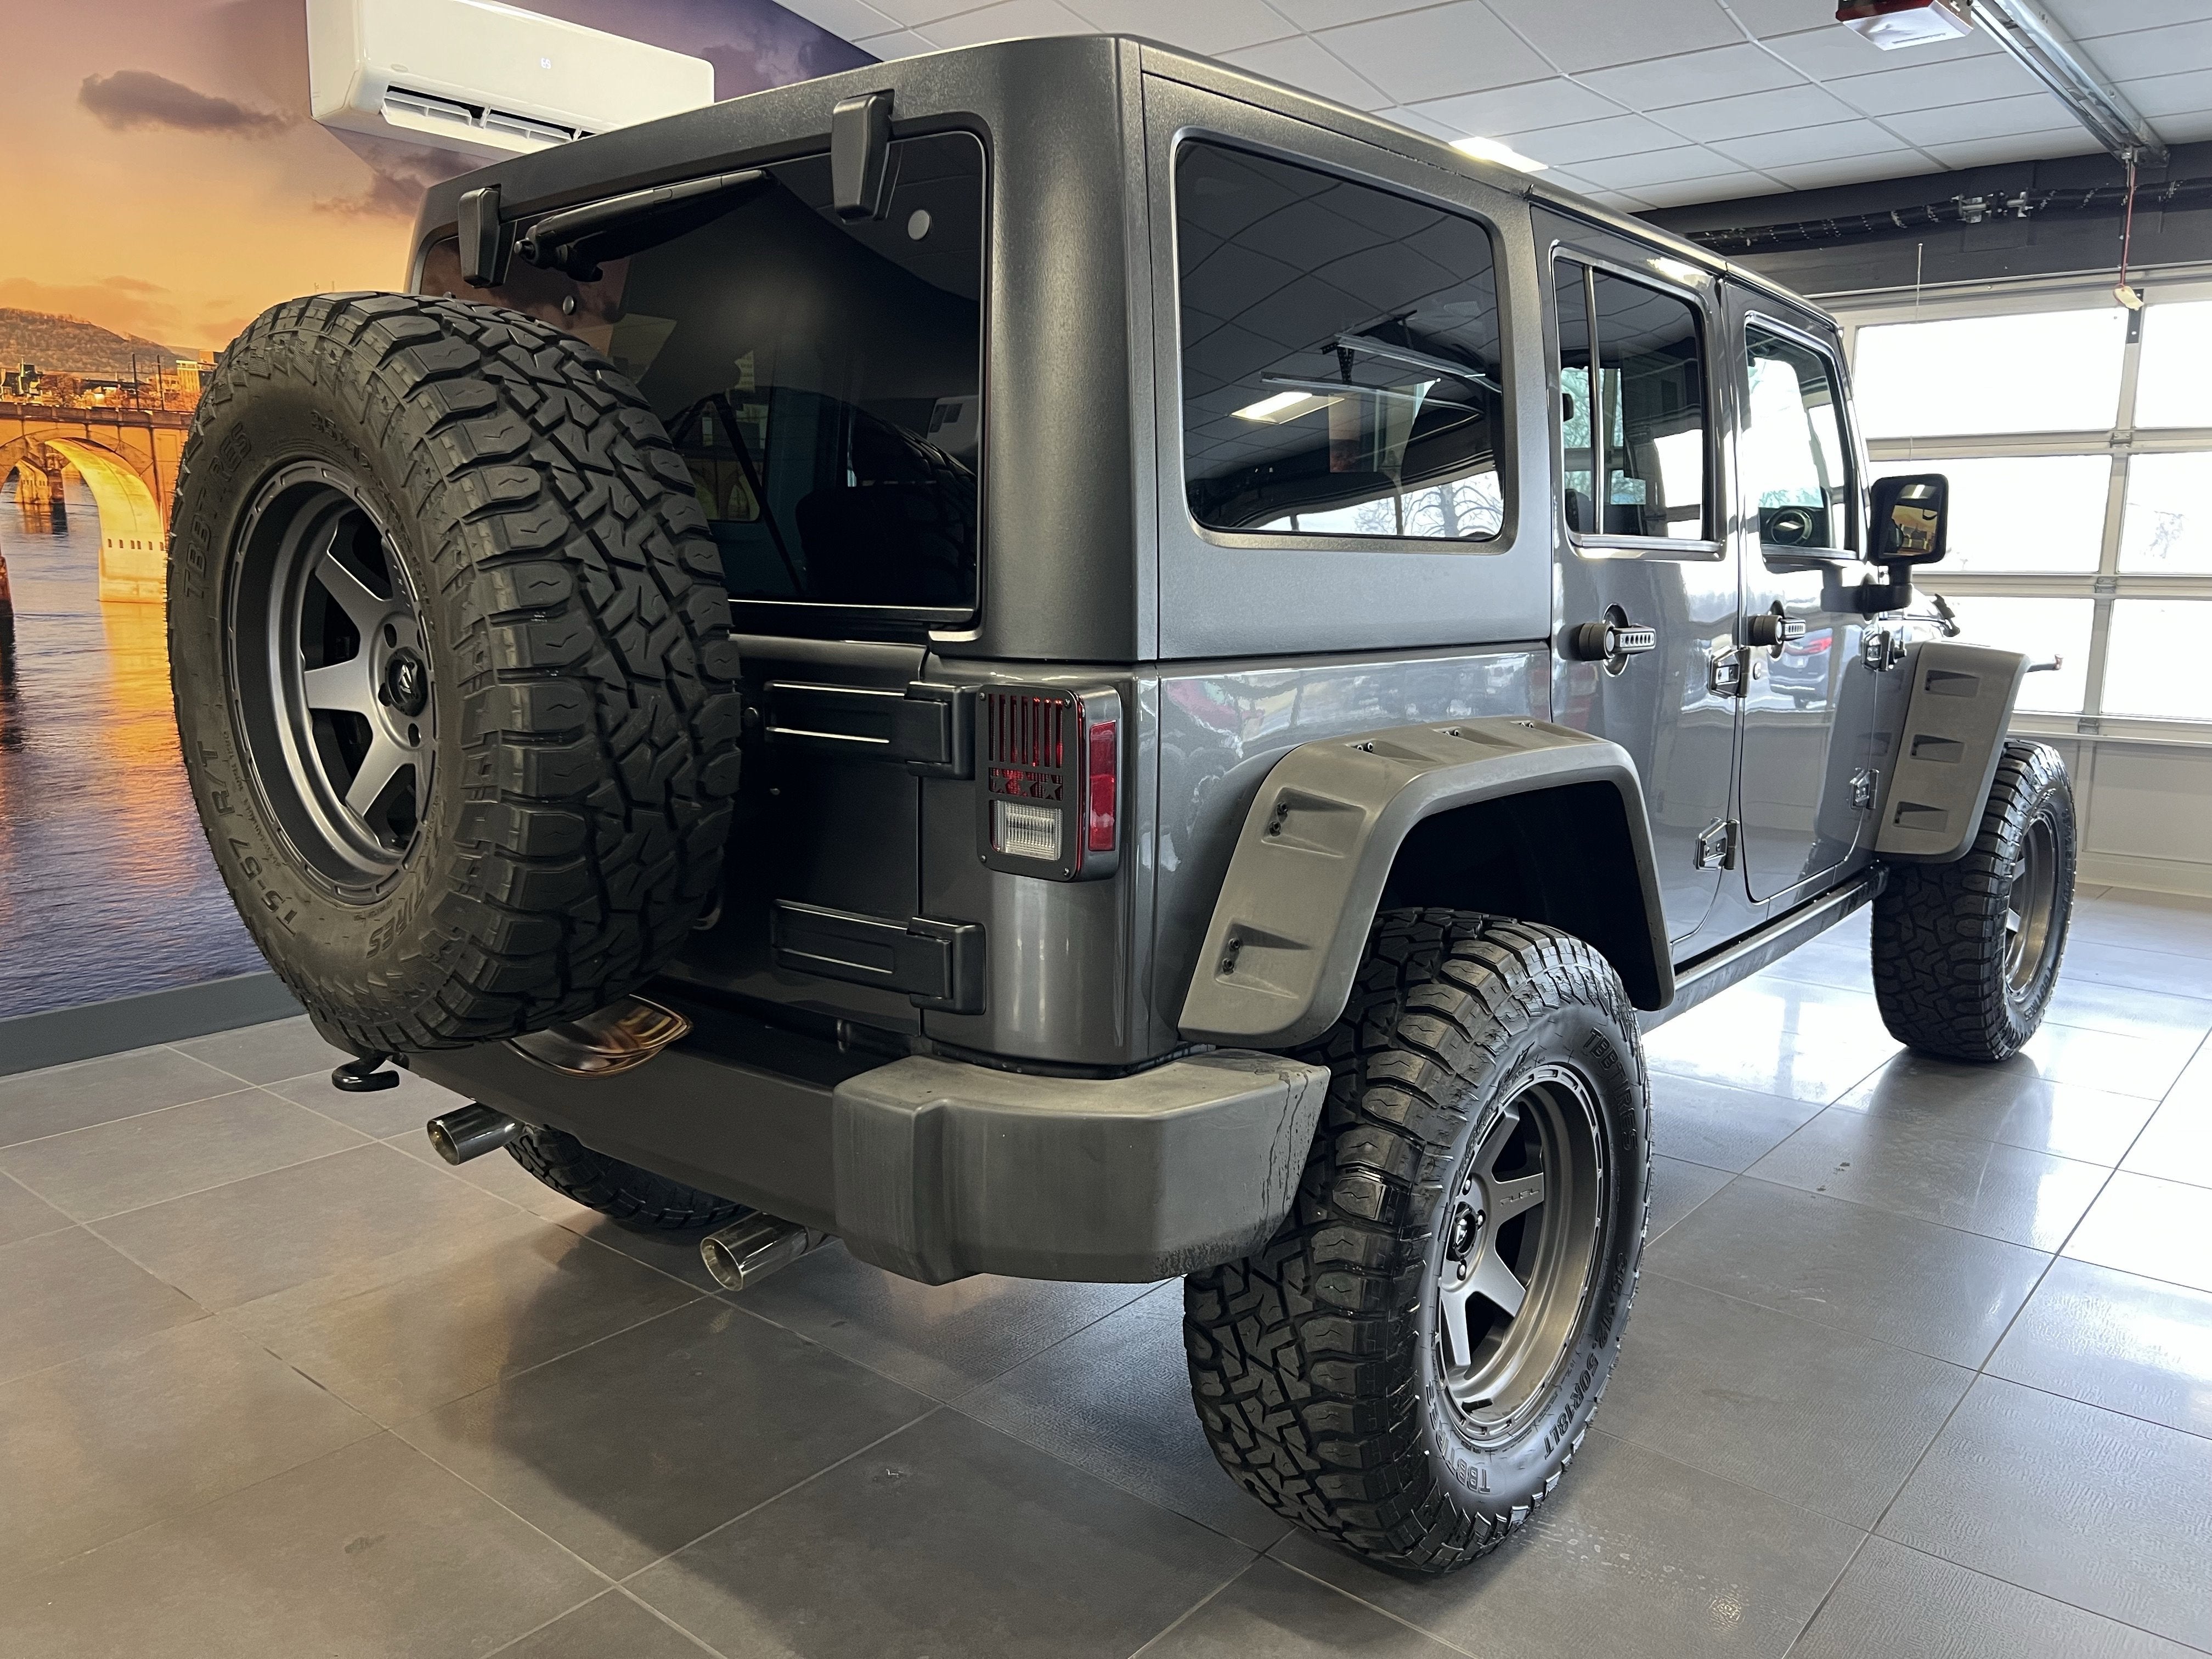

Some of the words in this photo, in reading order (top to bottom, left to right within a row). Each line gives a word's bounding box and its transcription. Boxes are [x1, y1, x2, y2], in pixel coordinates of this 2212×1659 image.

[184, 421, 252, 600] TBBTIRES
[197, 740, 235, 816] R/T
[228, 837, 296, 936] TS-57
[1582, 1027, 1639, 1151] TBBTIRES
